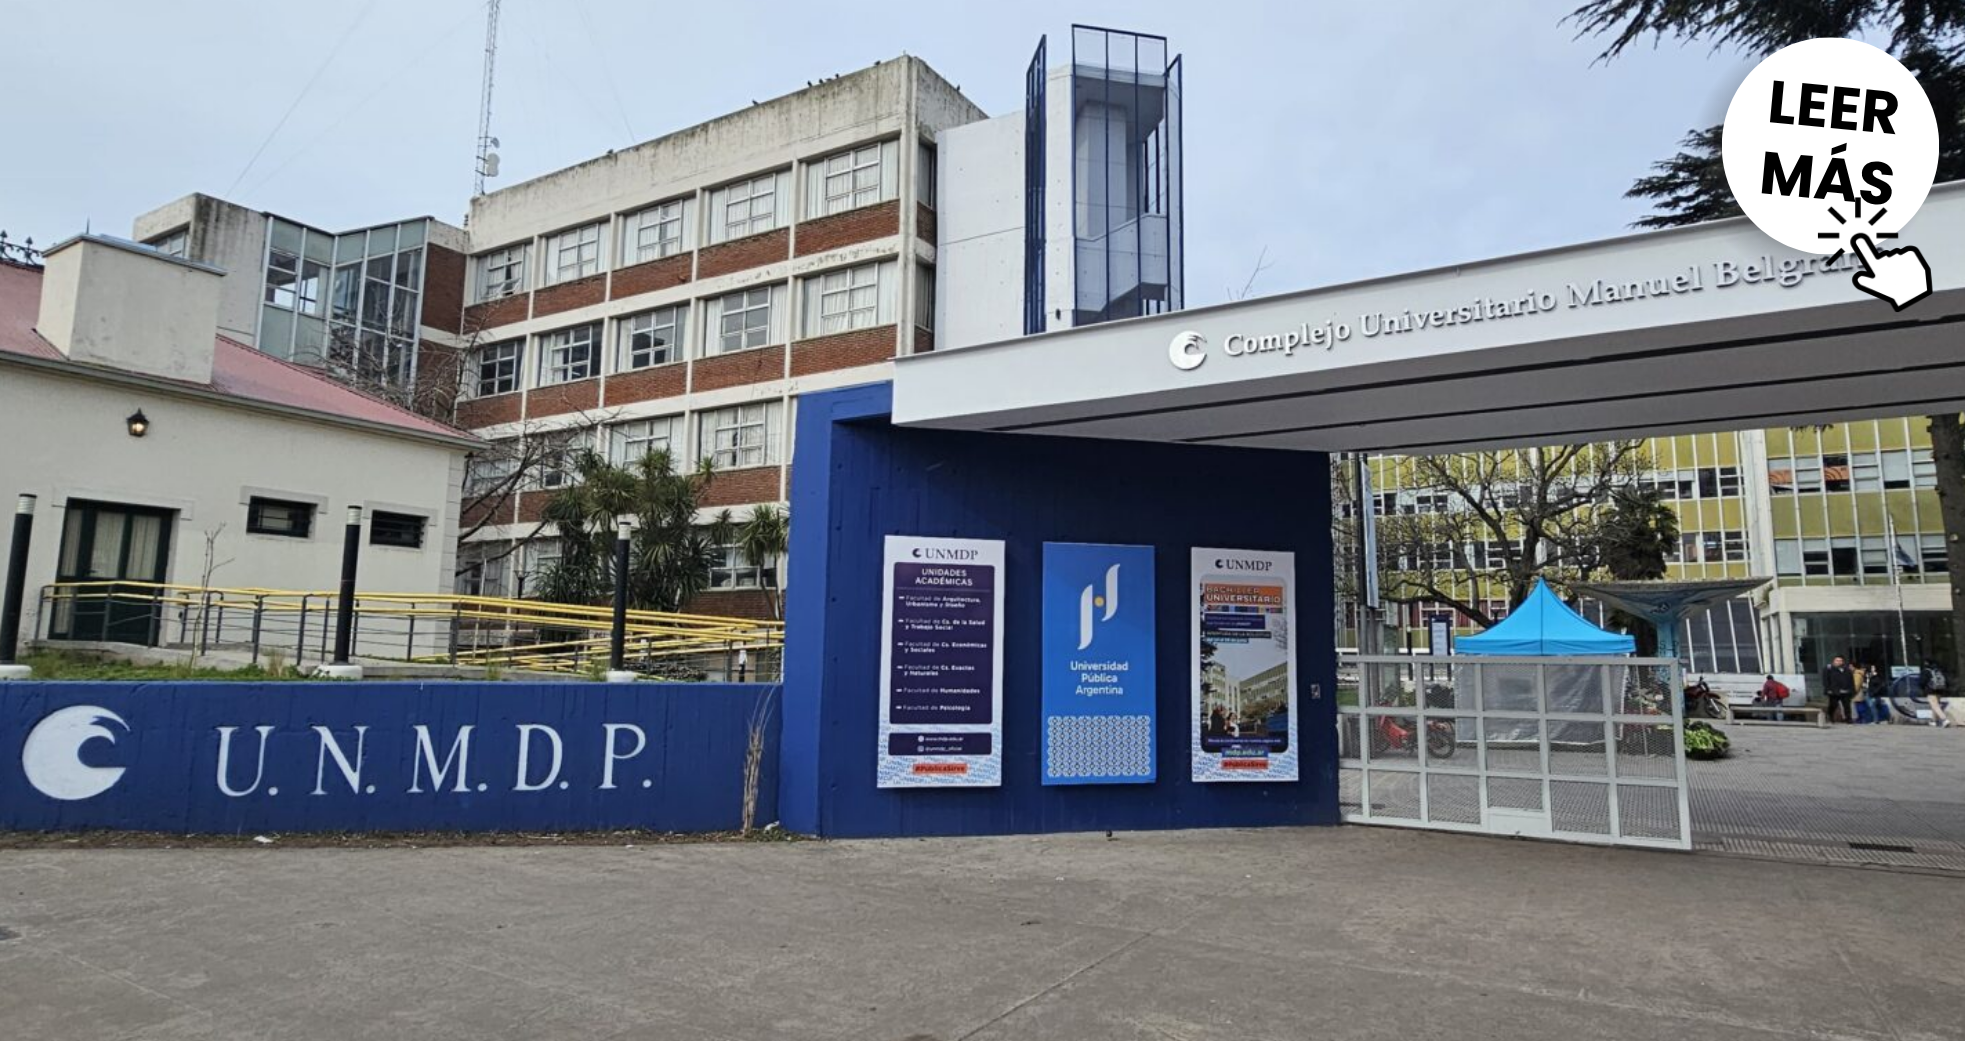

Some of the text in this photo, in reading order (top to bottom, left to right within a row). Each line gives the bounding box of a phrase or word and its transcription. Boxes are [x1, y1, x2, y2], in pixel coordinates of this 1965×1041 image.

[1224, 248, 1884, 356] Complejo Universitario Manuel Belgran
[925, 547, 979, 560] UNMDP
[1226, 559, 1273, 571] UNMDP
[921, 568, 967, 577] UNIDADES
[915, 576, 973, 586] ACADÉMICAS
[1206, 586, 1259, 595] BACHILLER
[1206, 594, 1281, 603] UNIVERSITARIO
[1070, 661, 1129, 671] Universidad
[1081, 672, 1118, 683] Pública
[1075, 684, 1124, 697] Argentina
